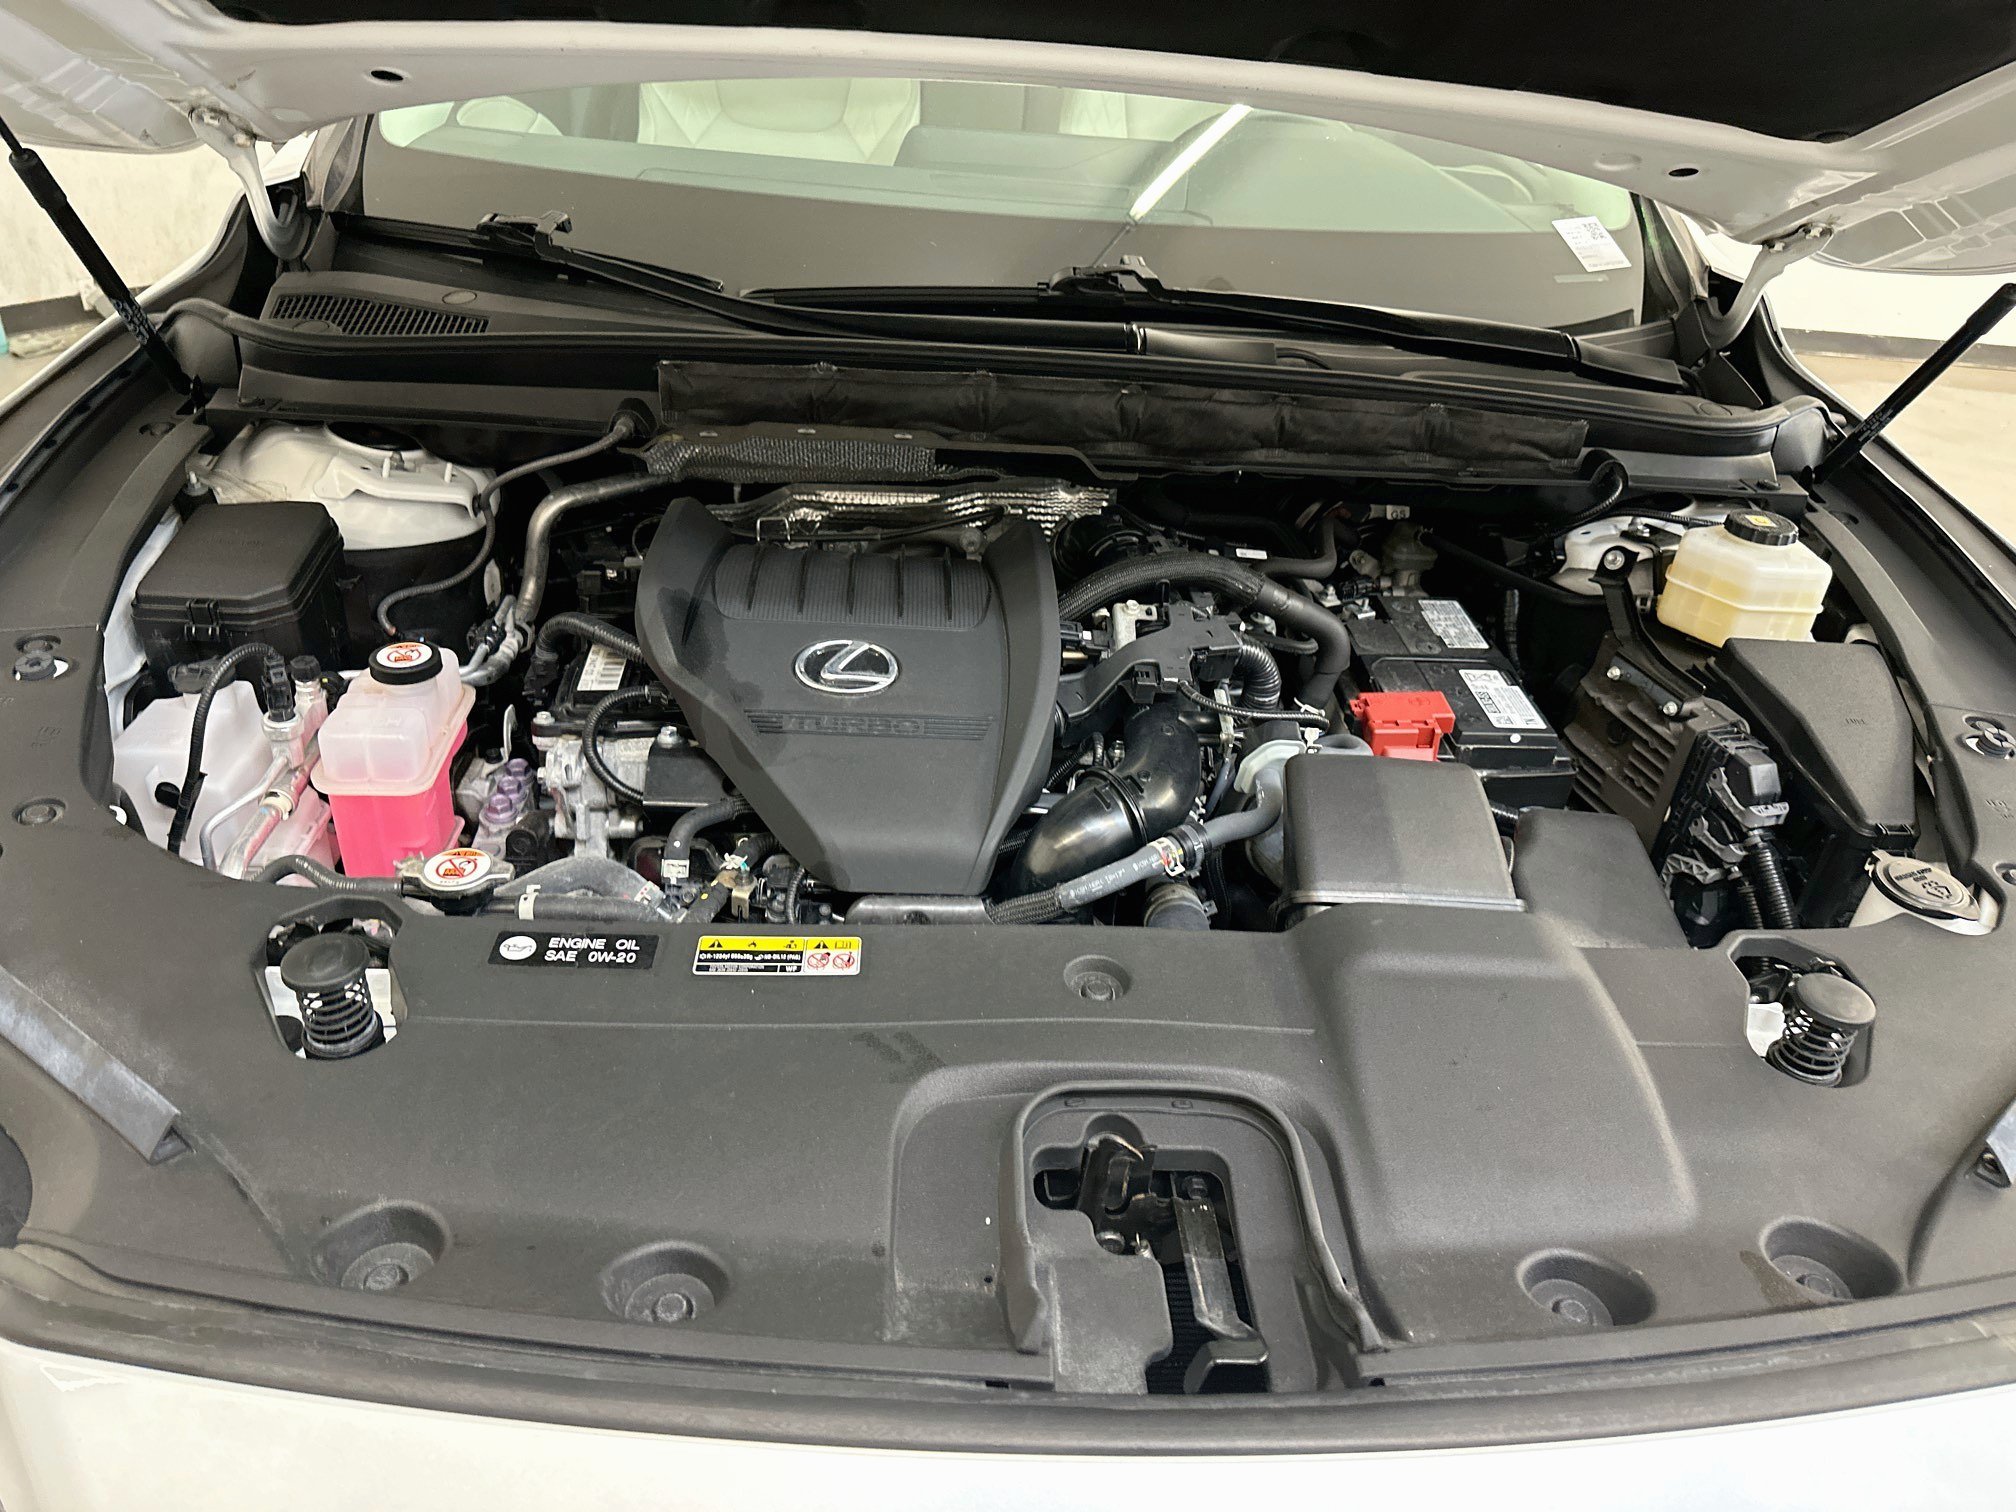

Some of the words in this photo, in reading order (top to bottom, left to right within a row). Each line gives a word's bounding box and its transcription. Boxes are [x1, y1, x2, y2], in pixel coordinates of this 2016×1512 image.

[787, 714, 921, 734] TURBO
[548, 937, 607, 950] ENGINE
[615, 939, 641, 951] OIL
[544, 949, 578, 962] SAE
[587, 951, 637, 964] 0W-20
